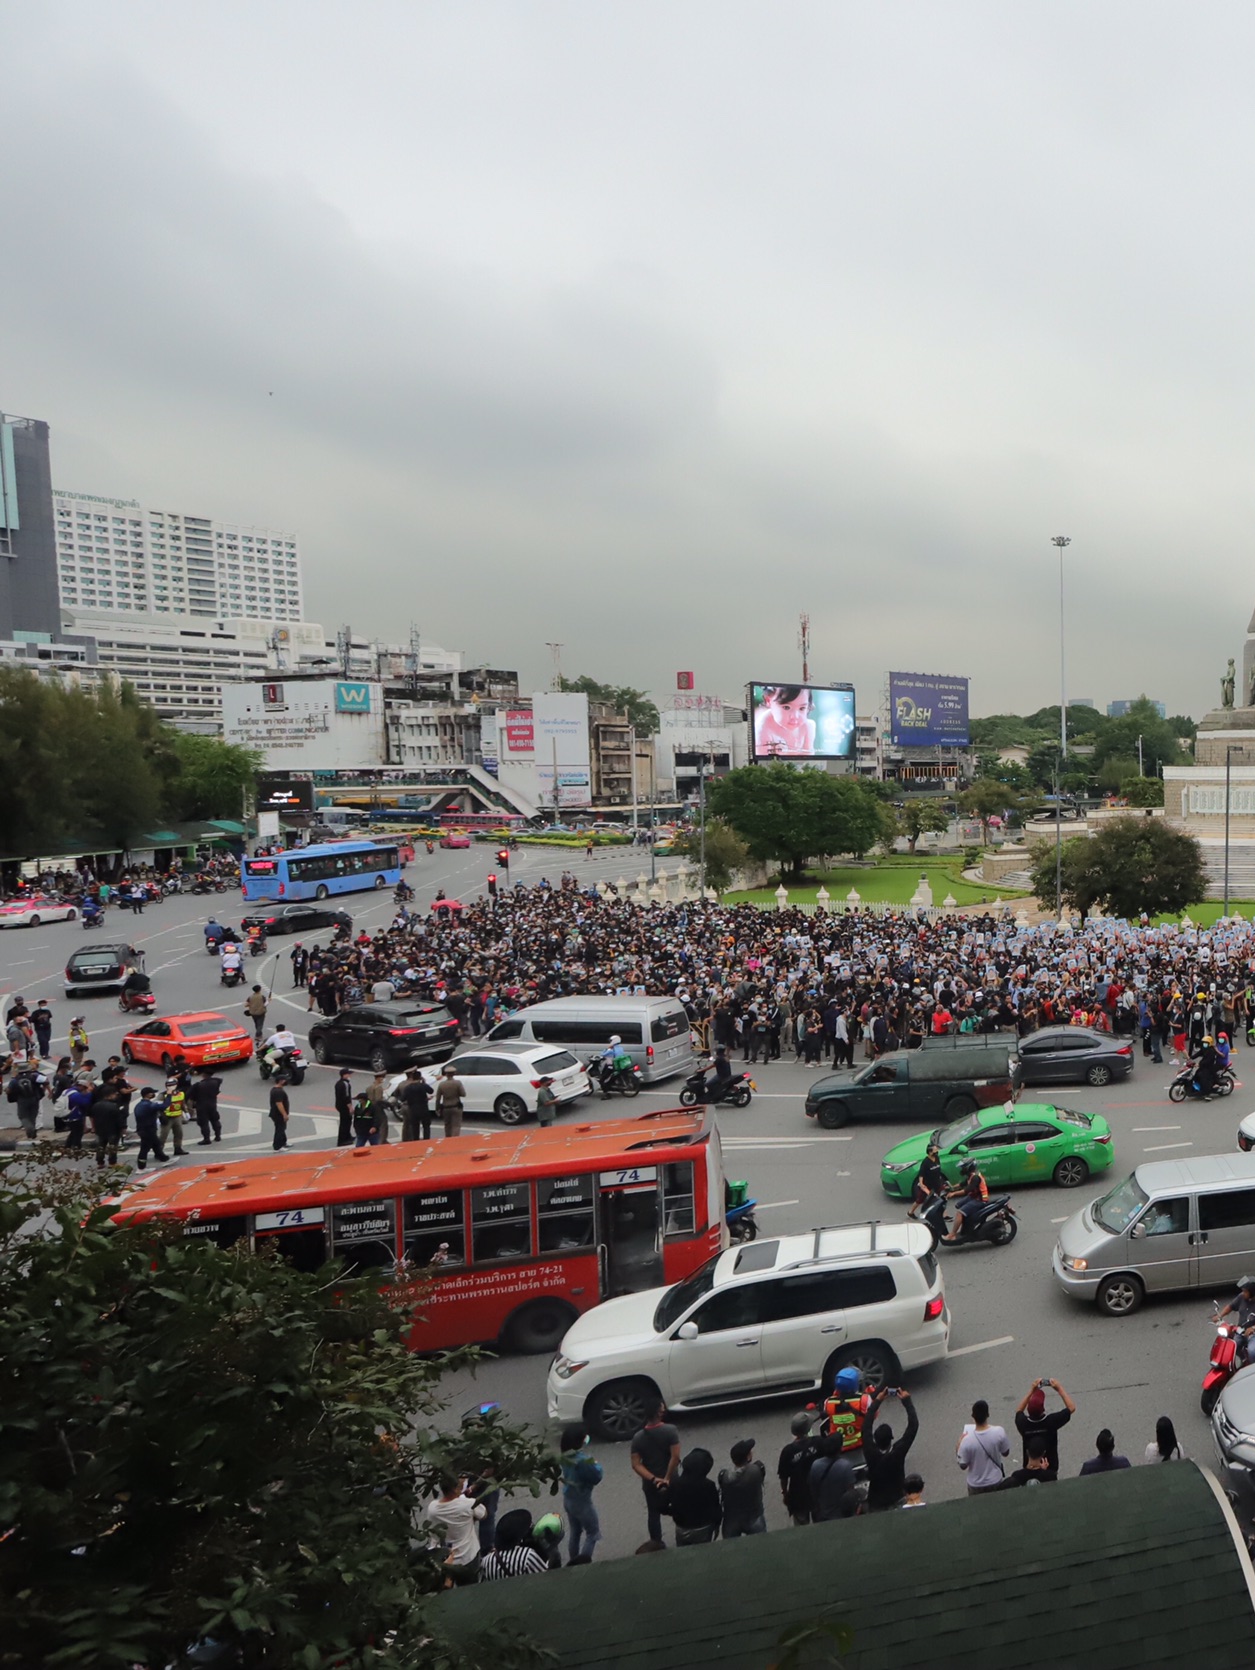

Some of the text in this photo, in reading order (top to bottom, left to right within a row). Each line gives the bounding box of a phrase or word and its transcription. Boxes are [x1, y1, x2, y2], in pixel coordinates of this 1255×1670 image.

[896, 706, 932, 721] FLASH
[616, 1170, 640, 1183] 74
[276, 1211, 304, 1226] 74
[519, 1269, 537, 1279] สาย
[539, 1264, 563, 1275] 74-21
